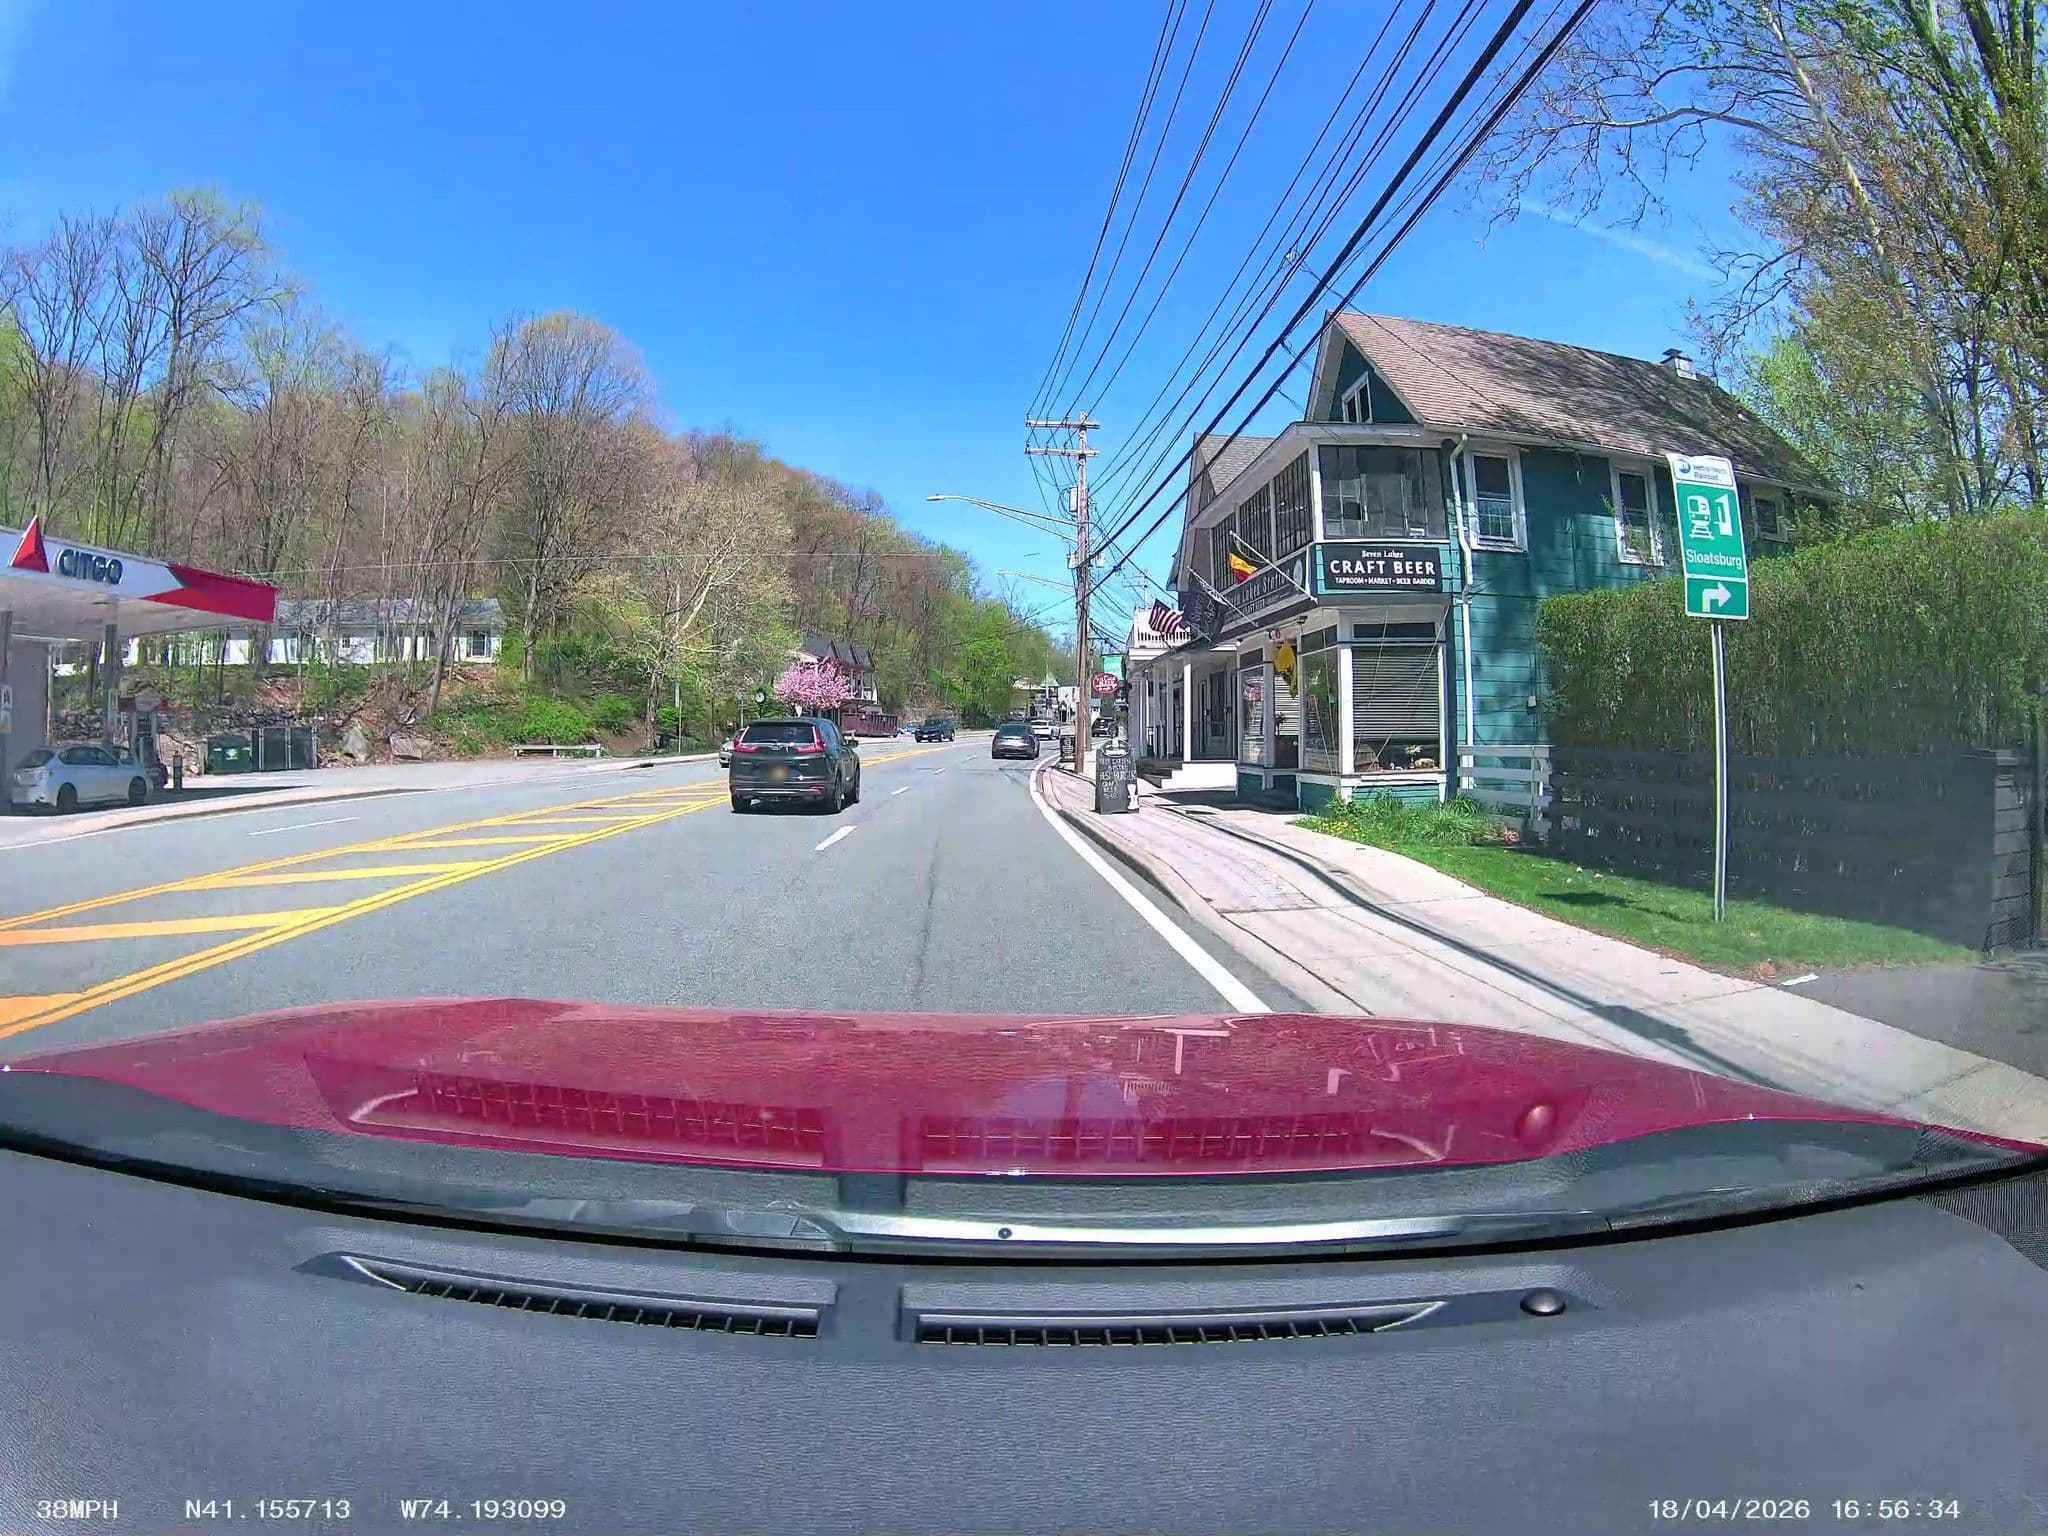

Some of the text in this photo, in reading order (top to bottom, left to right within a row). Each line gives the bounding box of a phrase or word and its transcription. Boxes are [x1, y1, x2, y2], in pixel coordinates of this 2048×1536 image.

[55, 548, 123, 585] CITGO
[1330, 560, 1436, 575] CRAFT BEER
[1686, 548, 1743, 569] Sloatsburg
[1335, 577, 1436, 586] TAPROOM MARKET BEER GARDEN
